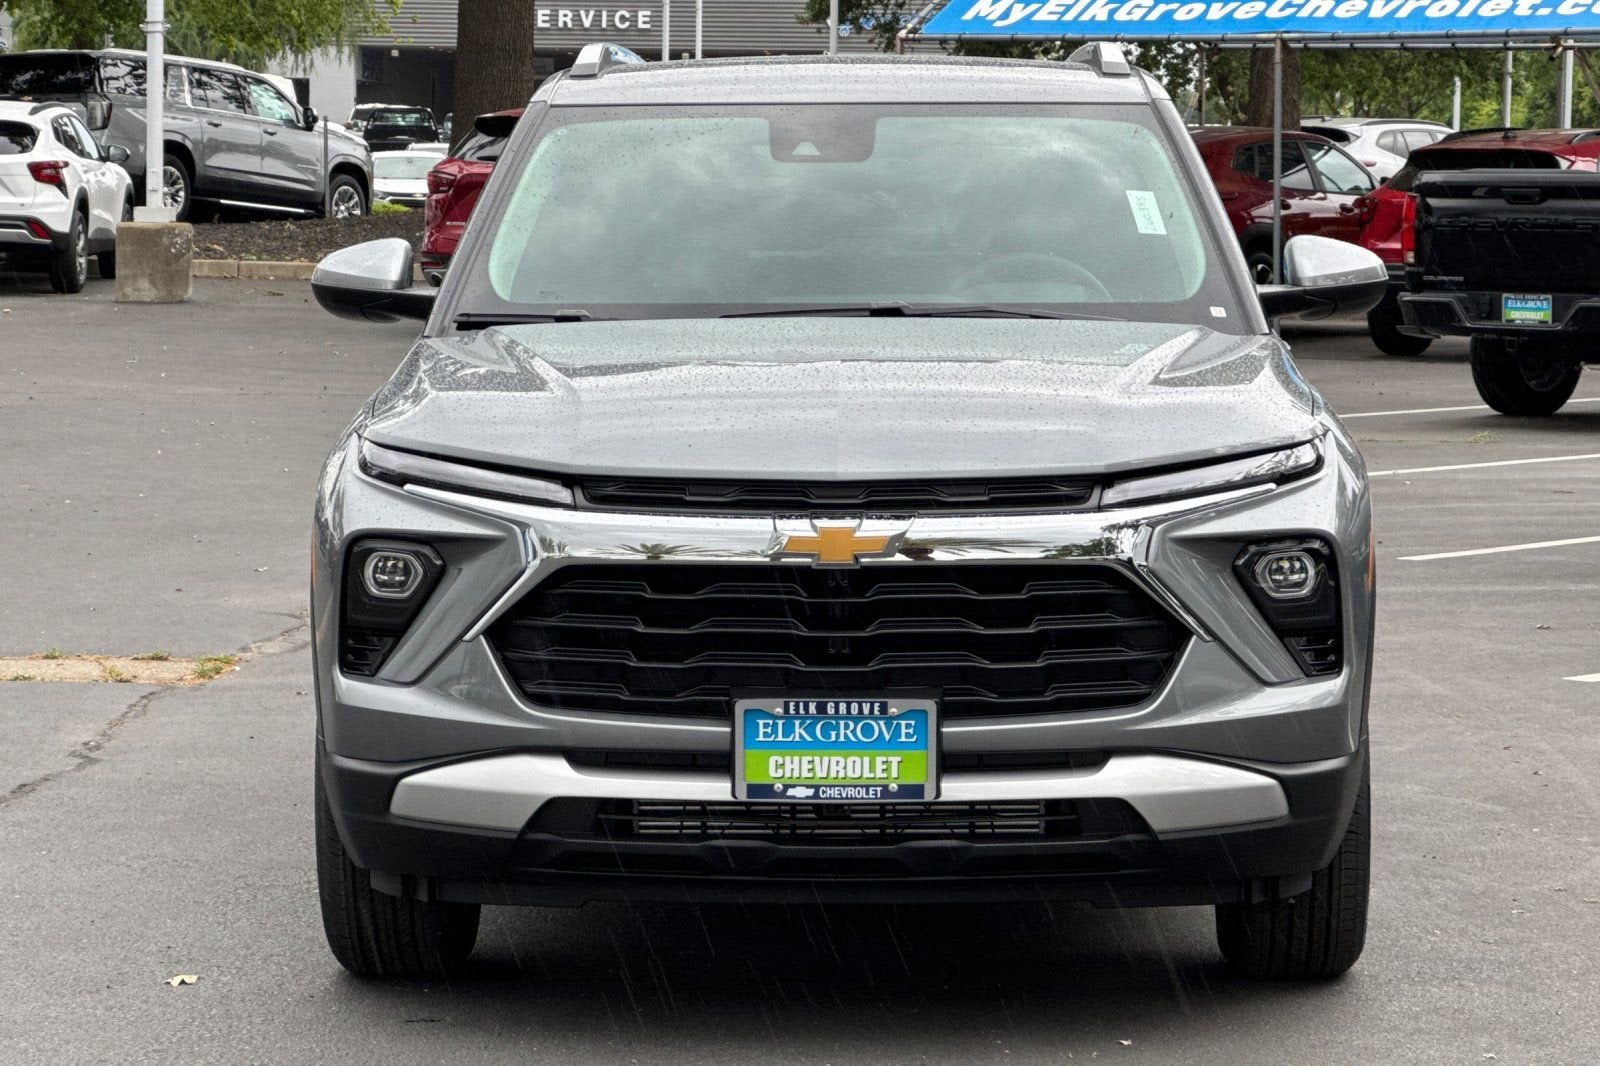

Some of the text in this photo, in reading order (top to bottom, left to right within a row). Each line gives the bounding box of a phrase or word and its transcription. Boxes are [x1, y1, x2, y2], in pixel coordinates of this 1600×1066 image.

[960, 0, 1600, 27] MyElkGroveChevrolet.c
[789, 701, 881, 715] ELK GROVE
[755, 718, 918, 743] ELK GROVE
[768, 755, 903, 779] CHEVROLET
[819, 786, 883, 799] CHEVROLET
